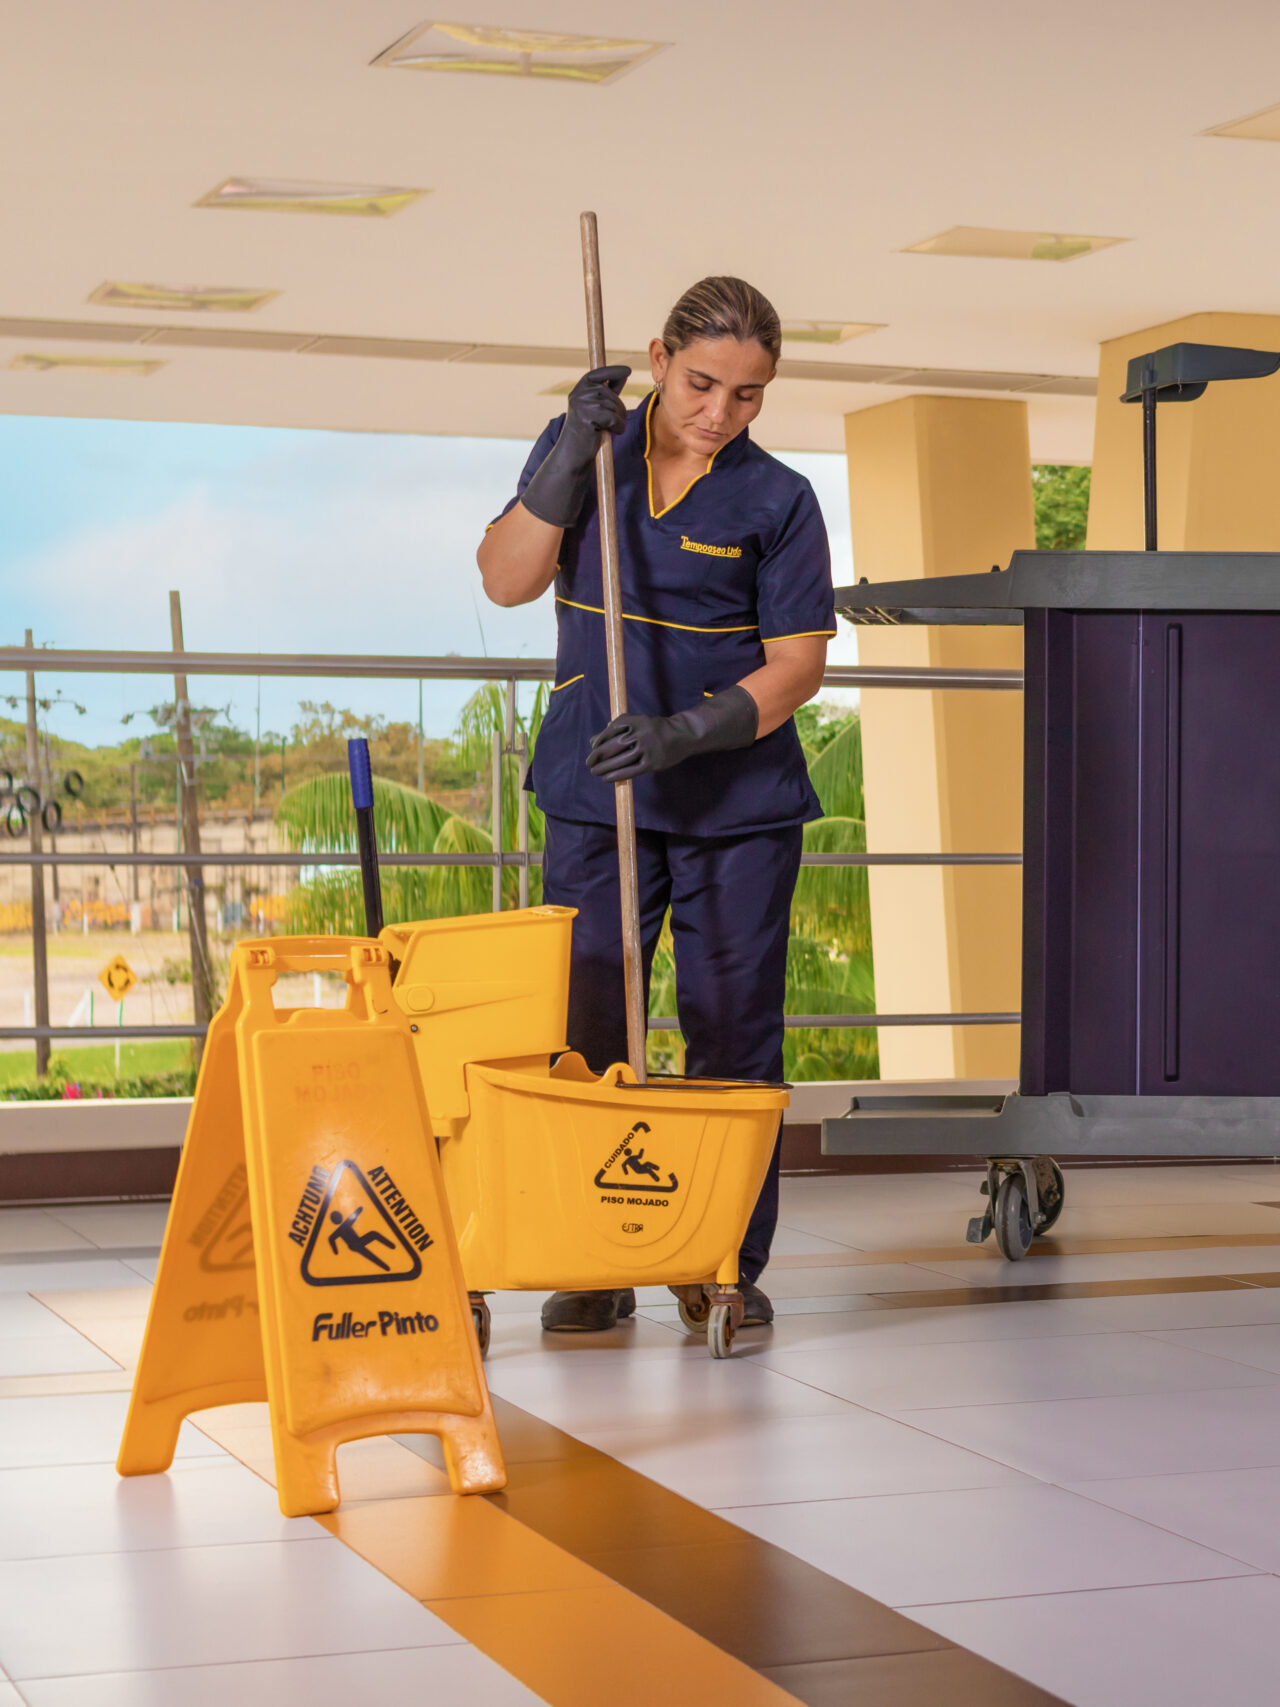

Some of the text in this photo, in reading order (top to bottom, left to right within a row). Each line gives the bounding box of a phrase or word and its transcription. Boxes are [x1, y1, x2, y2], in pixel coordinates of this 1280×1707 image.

[604, 1132, 635, 1169] CUIDADO
[288, 1165, 331, 1248] ACHTUNG
[367, 1165, 435, 1252] ATTENTION
[601, 1196, 669, 1207] PISO MOJADO
